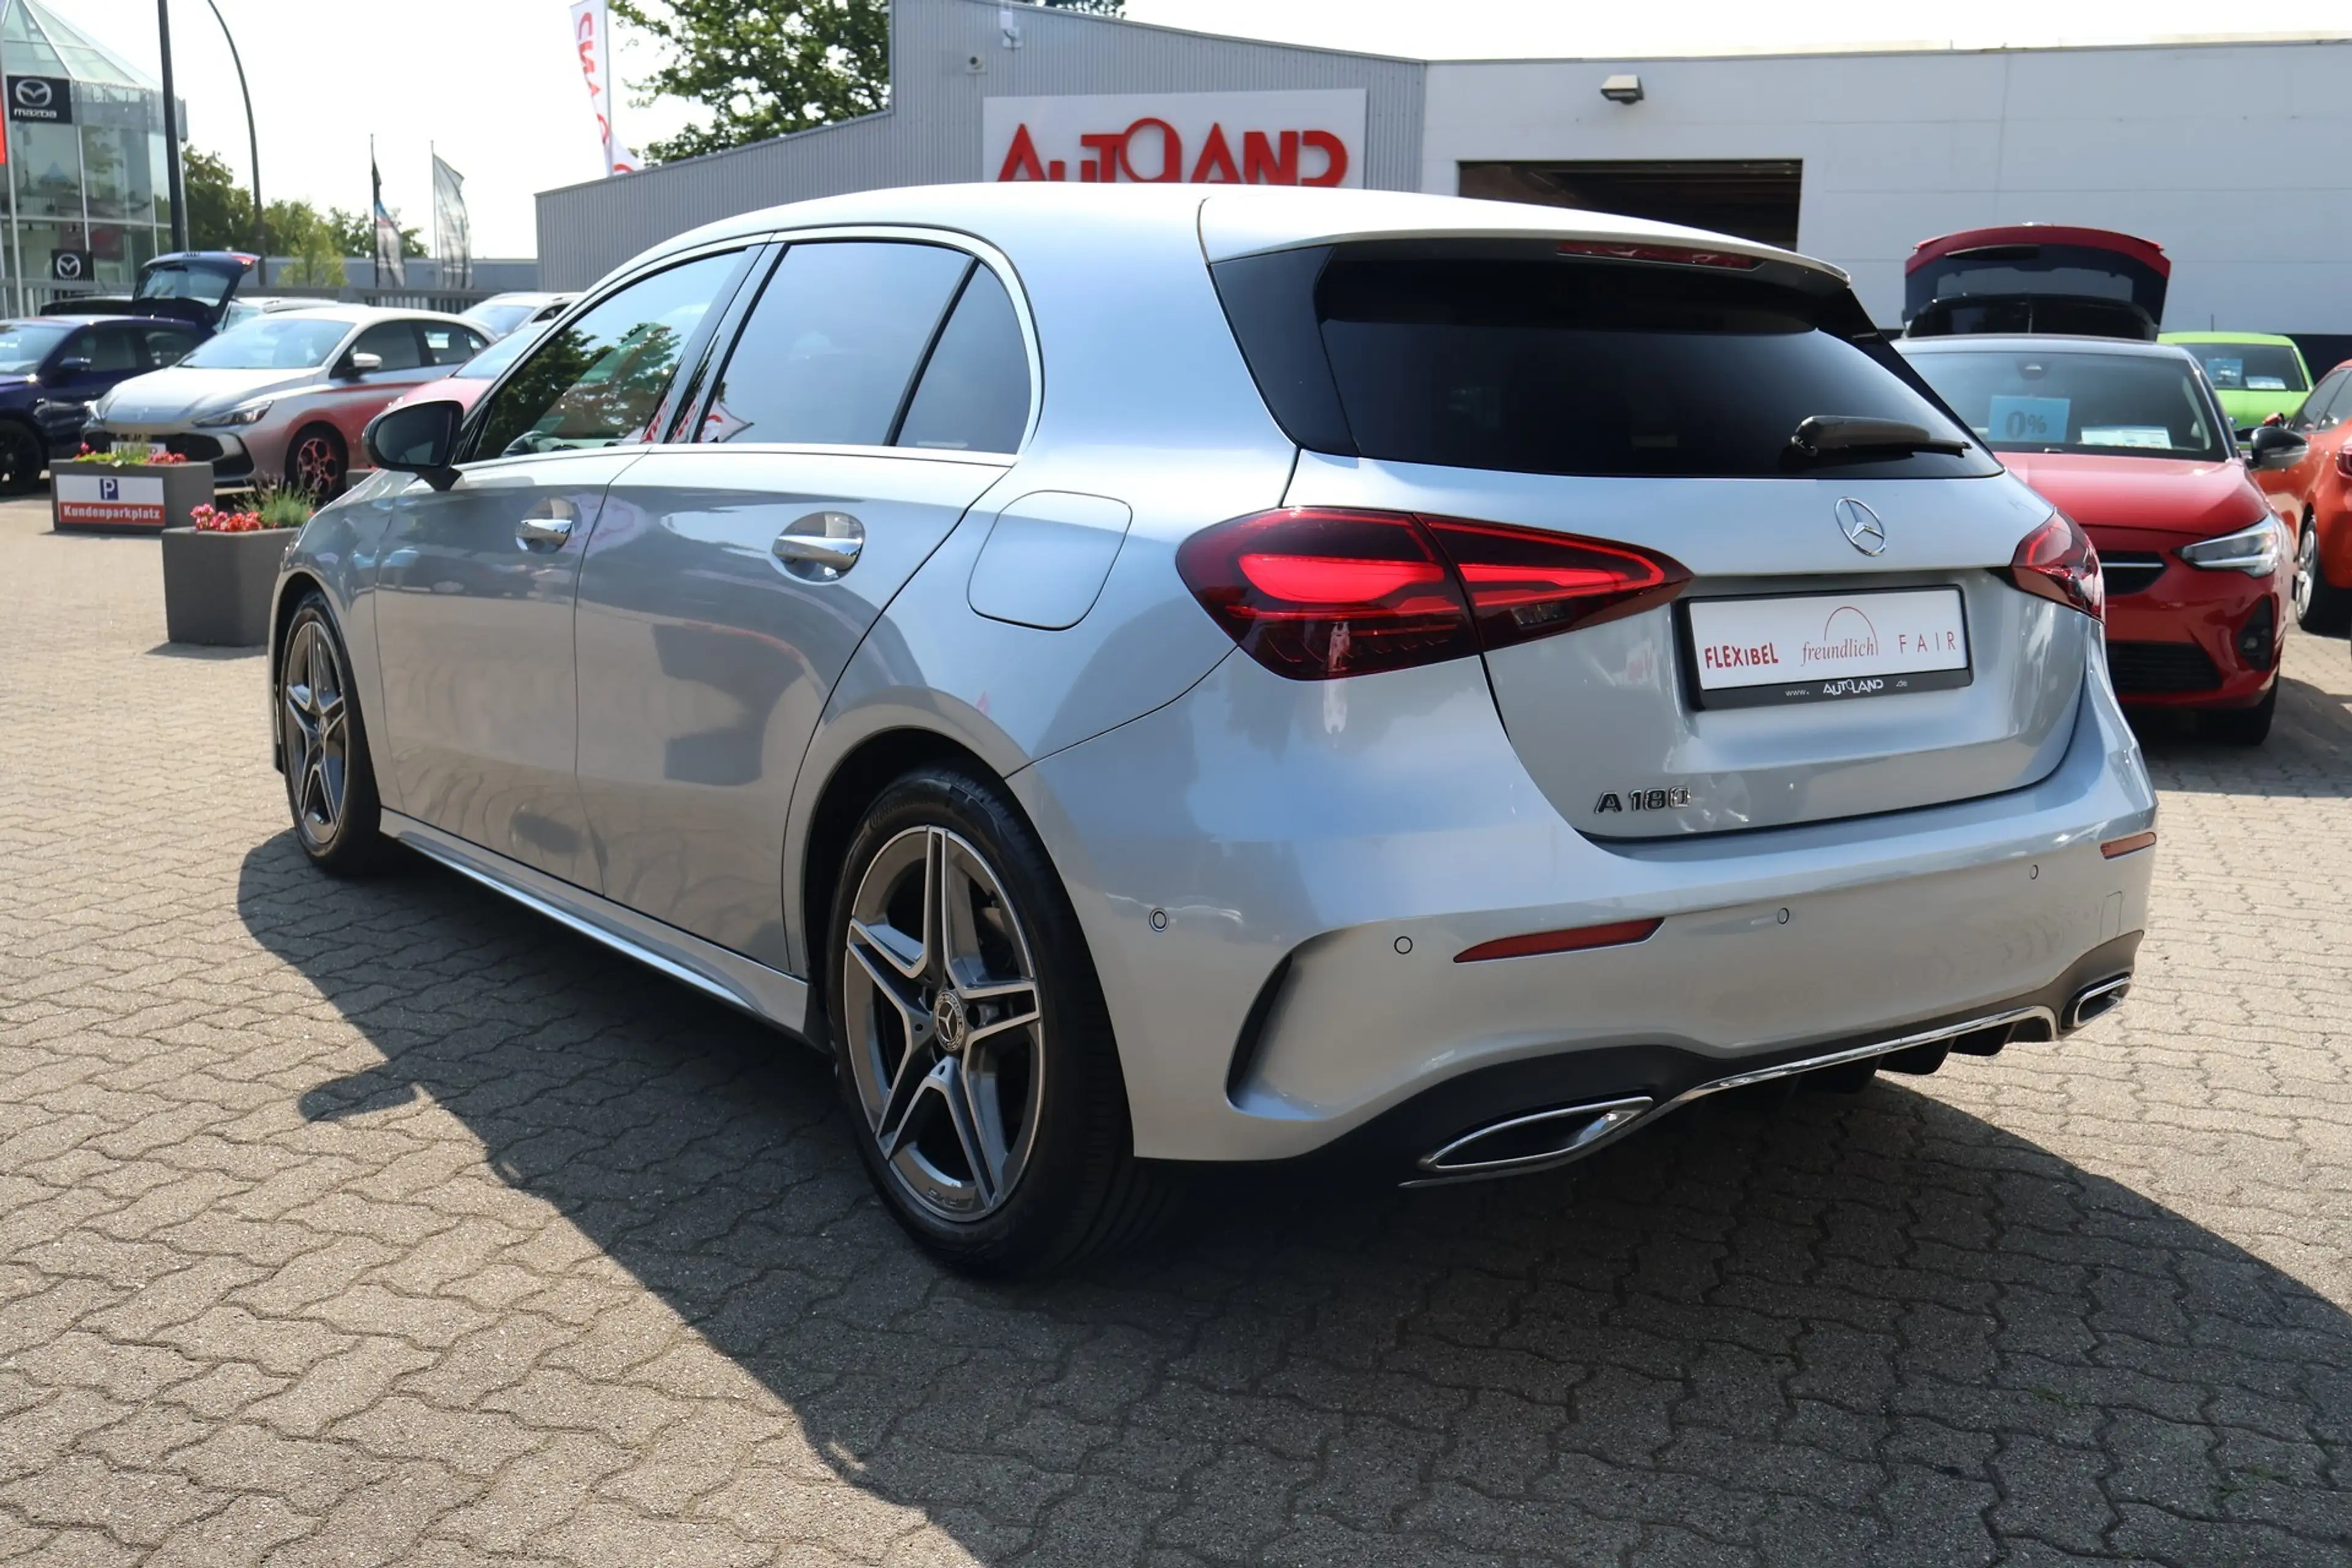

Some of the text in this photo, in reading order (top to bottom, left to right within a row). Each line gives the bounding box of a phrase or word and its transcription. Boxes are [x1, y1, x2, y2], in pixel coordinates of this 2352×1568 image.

[2005, 410, 2048, 439] 0%
[102, 479, 115, 500] P
[63, 505, 161, 521] Kundenparkplatz
[1704, 631, 1956, 669] FLEXIBEL freundlich FAIR
[1822, 679, 1884, 696] AUTOLAND
[1594, 786, 1692, 813] A 180
